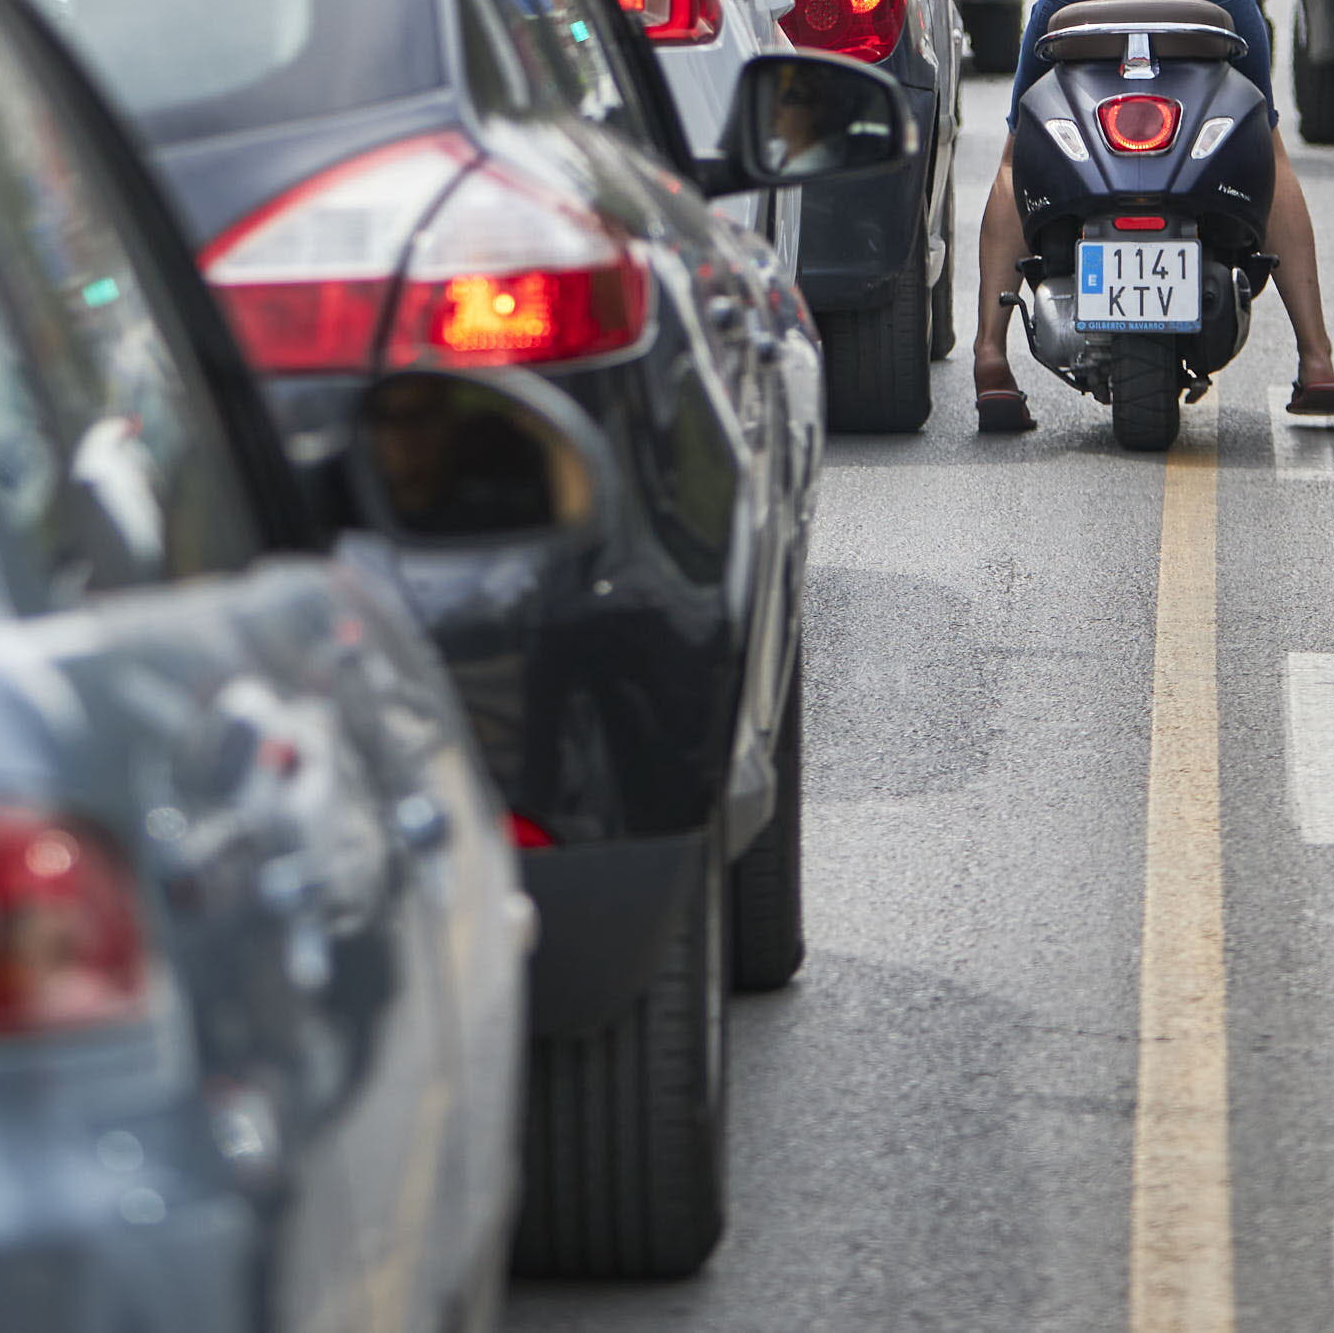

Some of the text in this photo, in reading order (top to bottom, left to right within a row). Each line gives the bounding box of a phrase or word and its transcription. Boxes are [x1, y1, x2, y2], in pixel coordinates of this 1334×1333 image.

[1113, 248, 1187, 280] 1141
[1088, 273, 1098, 287] E
[1109, 286, 1173, 317] KTV
[1088, 321, 1126, 331] GILBERTO
[1129, 321, 1165, 331] NAVARRO
